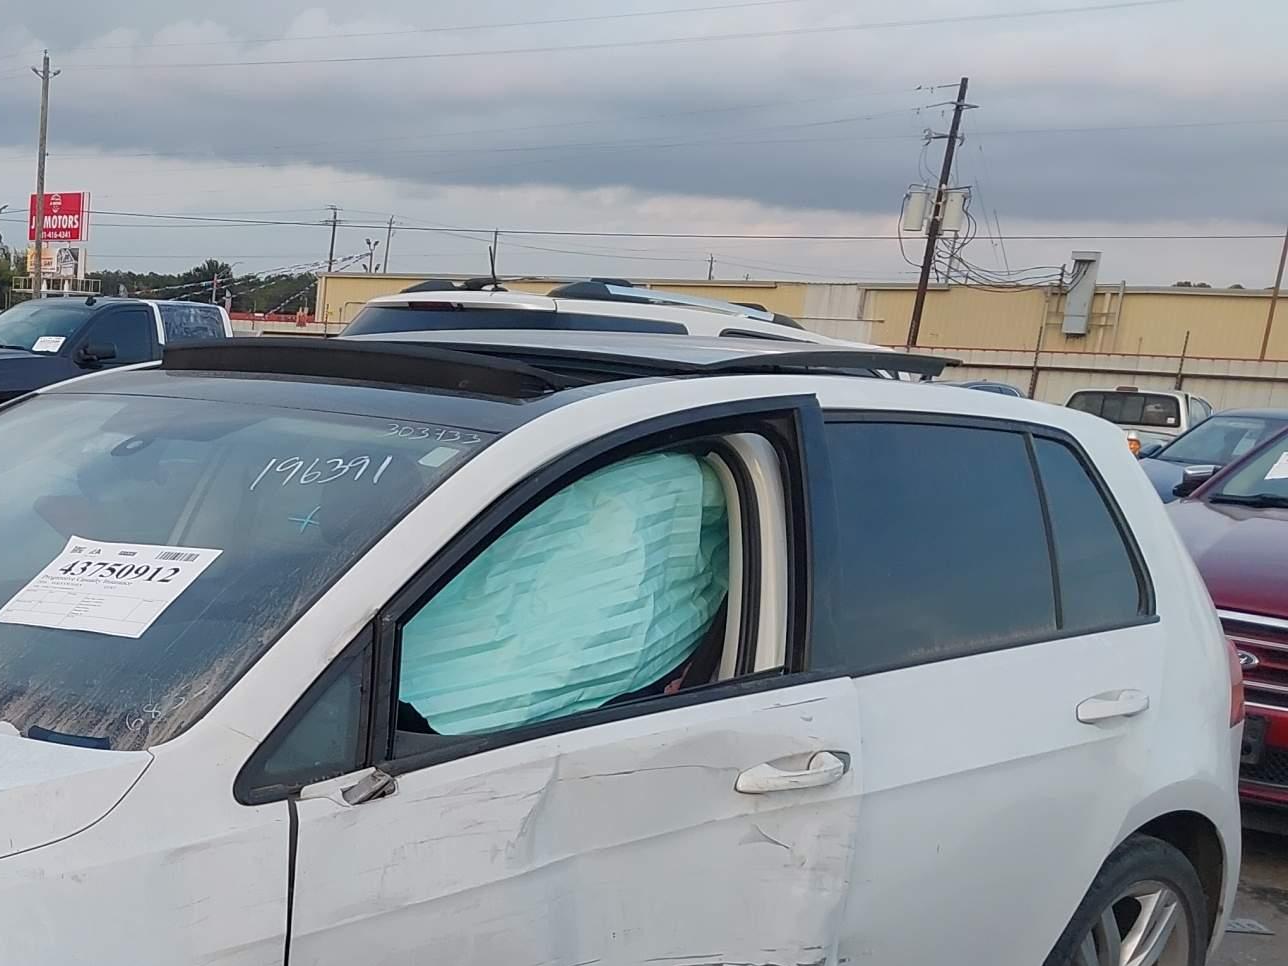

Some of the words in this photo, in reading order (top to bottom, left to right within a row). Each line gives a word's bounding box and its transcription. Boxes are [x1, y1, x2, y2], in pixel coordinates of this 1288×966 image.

[43, 214, 79, 229] MOTORS
[249, 455, 393, 491] 196391
[58, 560, 180, 583] 43750912
